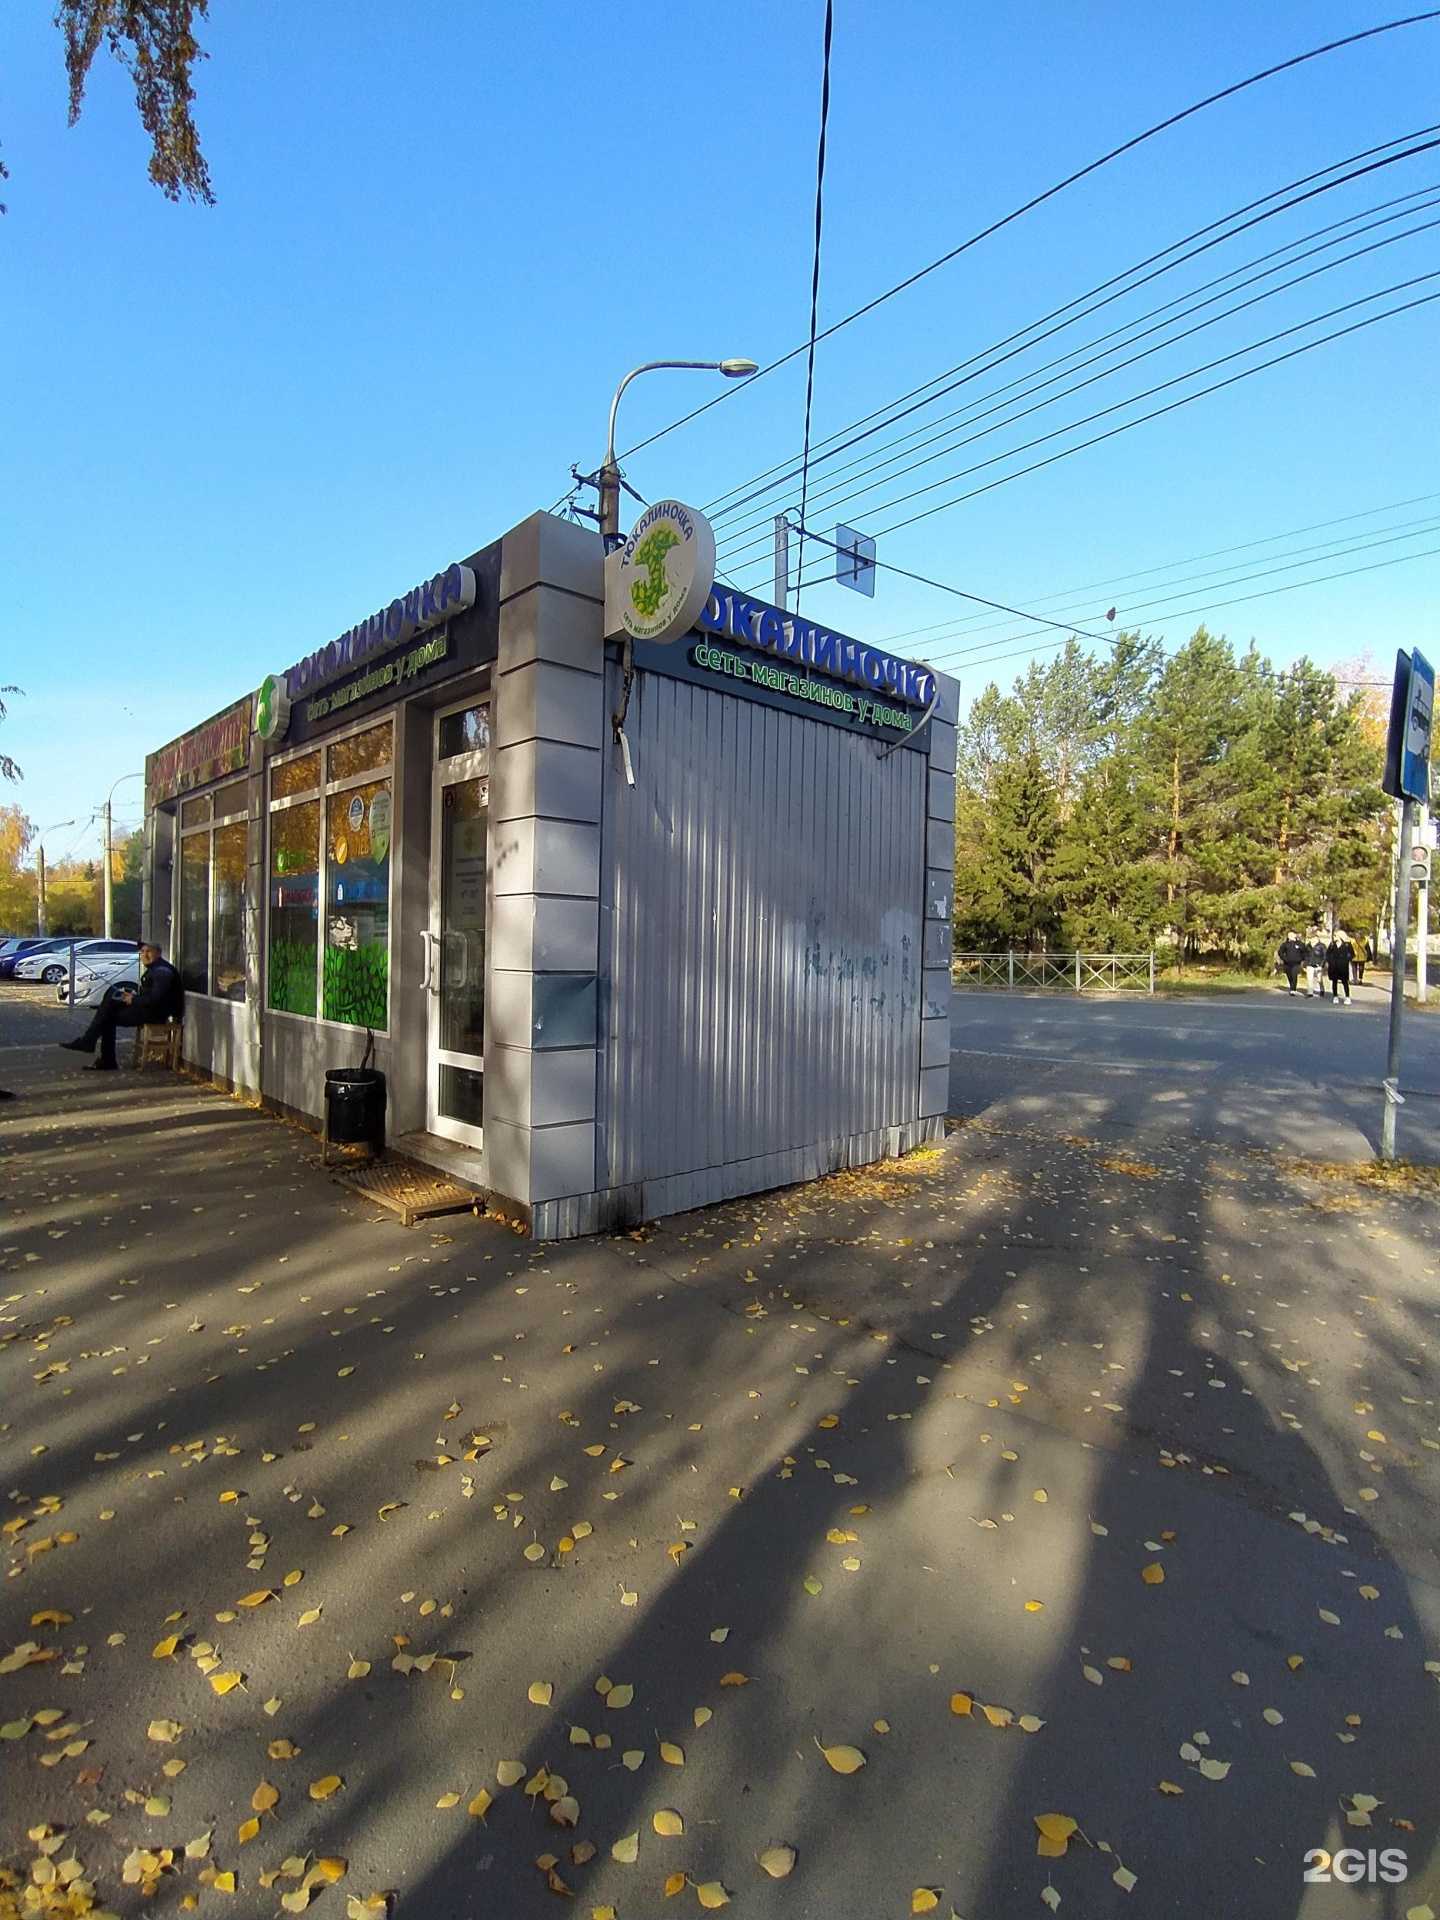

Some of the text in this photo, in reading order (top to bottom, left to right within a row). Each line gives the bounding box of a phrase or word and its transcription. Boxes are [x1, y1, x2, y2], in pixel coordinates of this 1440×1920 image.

[620, 503, 694, 569] ТЮКАЛИНОЧКА
[694, 644, 913, 732] сеть магазинов у дома
